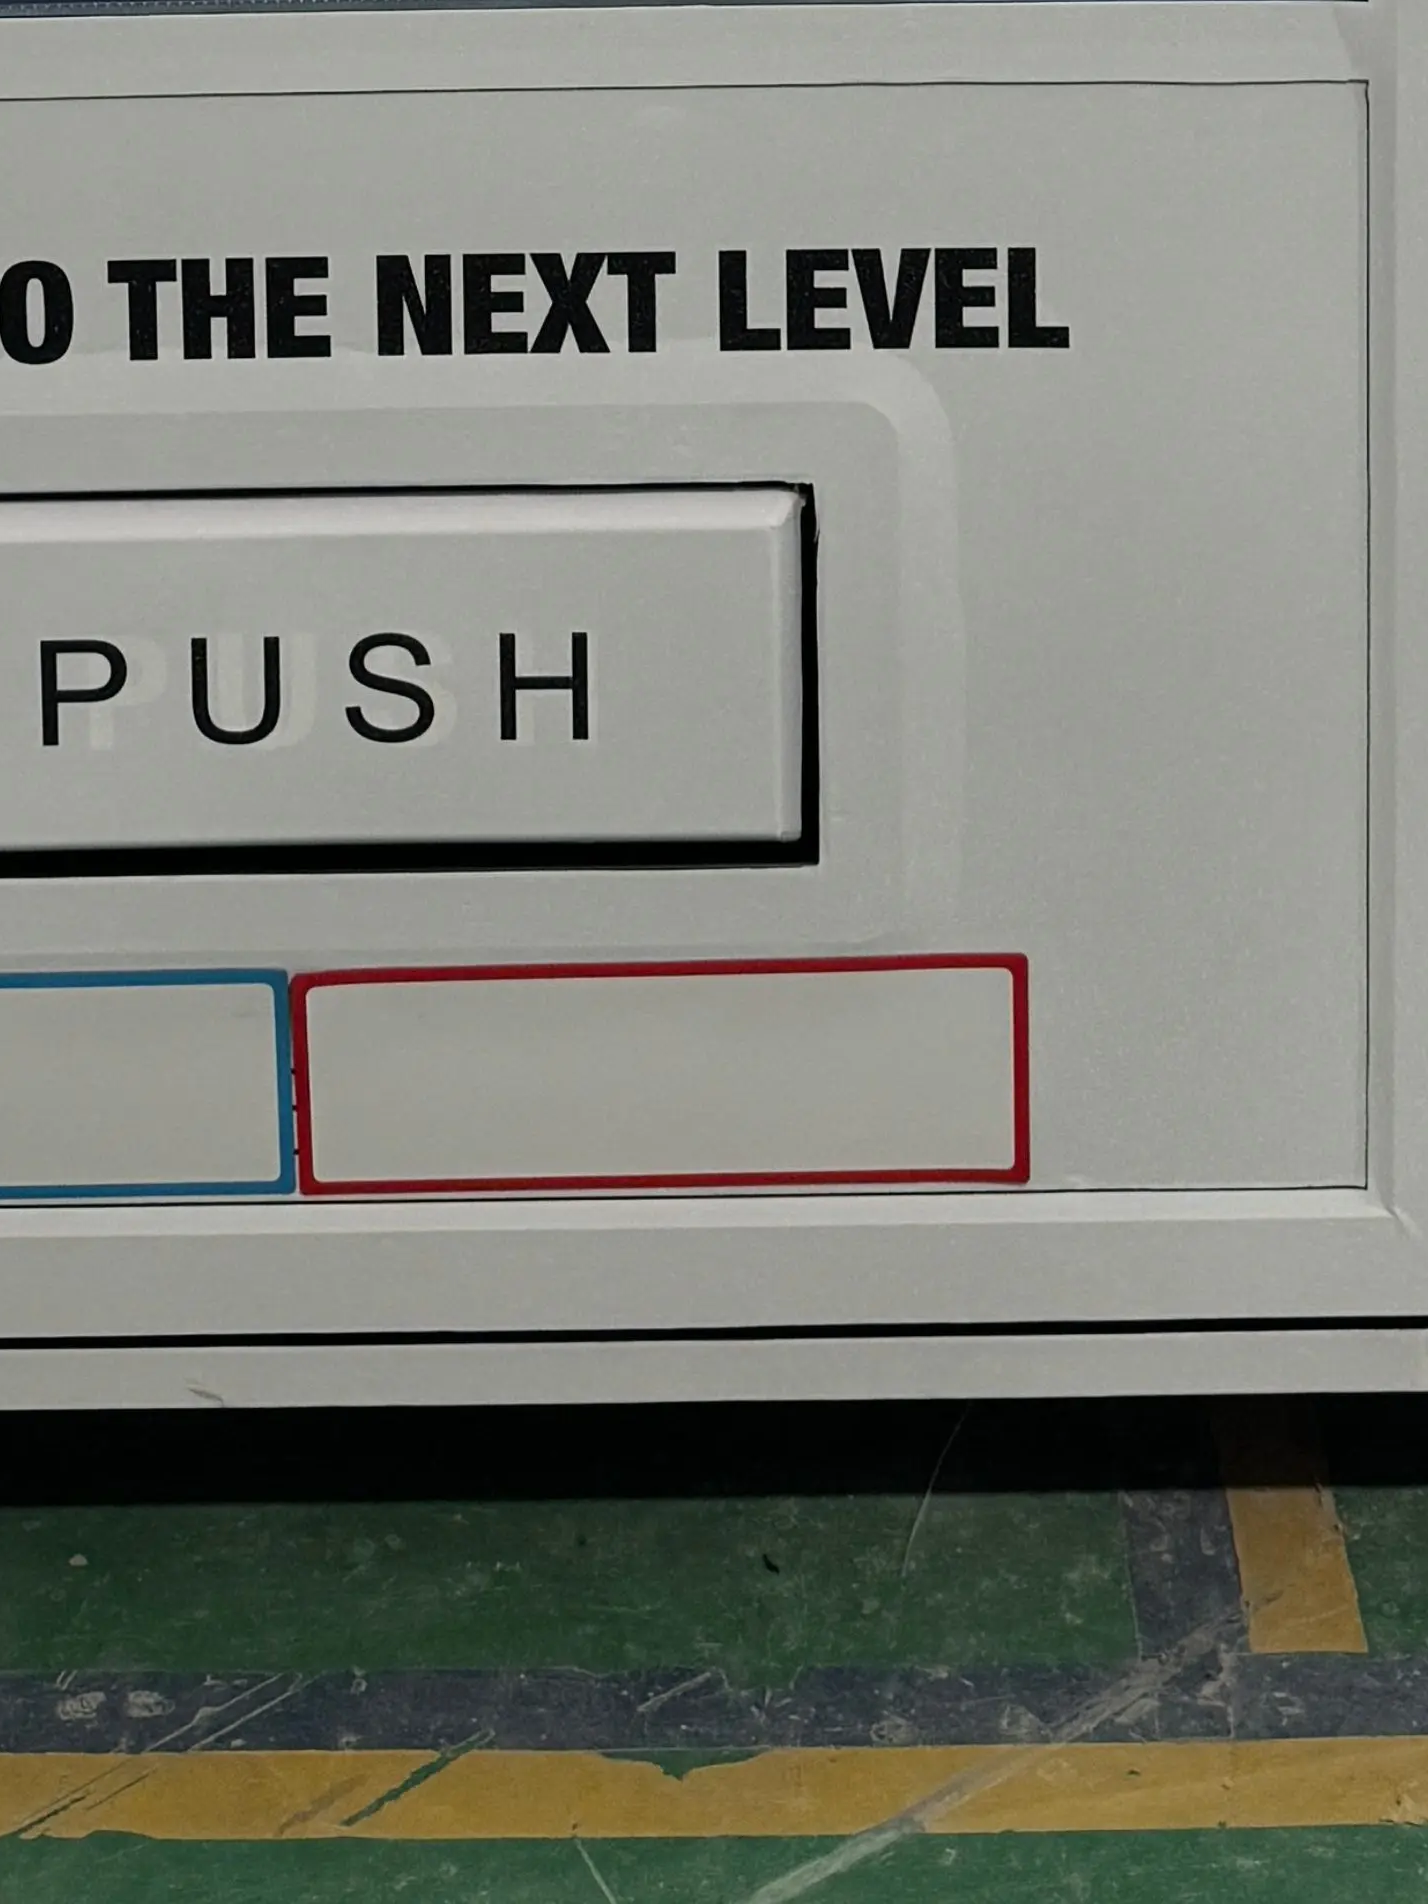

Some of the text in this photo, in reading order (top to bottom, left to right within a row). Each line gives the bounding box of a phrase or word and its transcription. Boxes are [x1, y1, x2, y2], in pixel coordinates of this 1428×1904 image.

[108, 257, 331, 360] THE
[377, 252, 676, 355] NEXT
[719, 248, 1069, 351] LEVEL
[40, 632, 588, 745] PUSH
